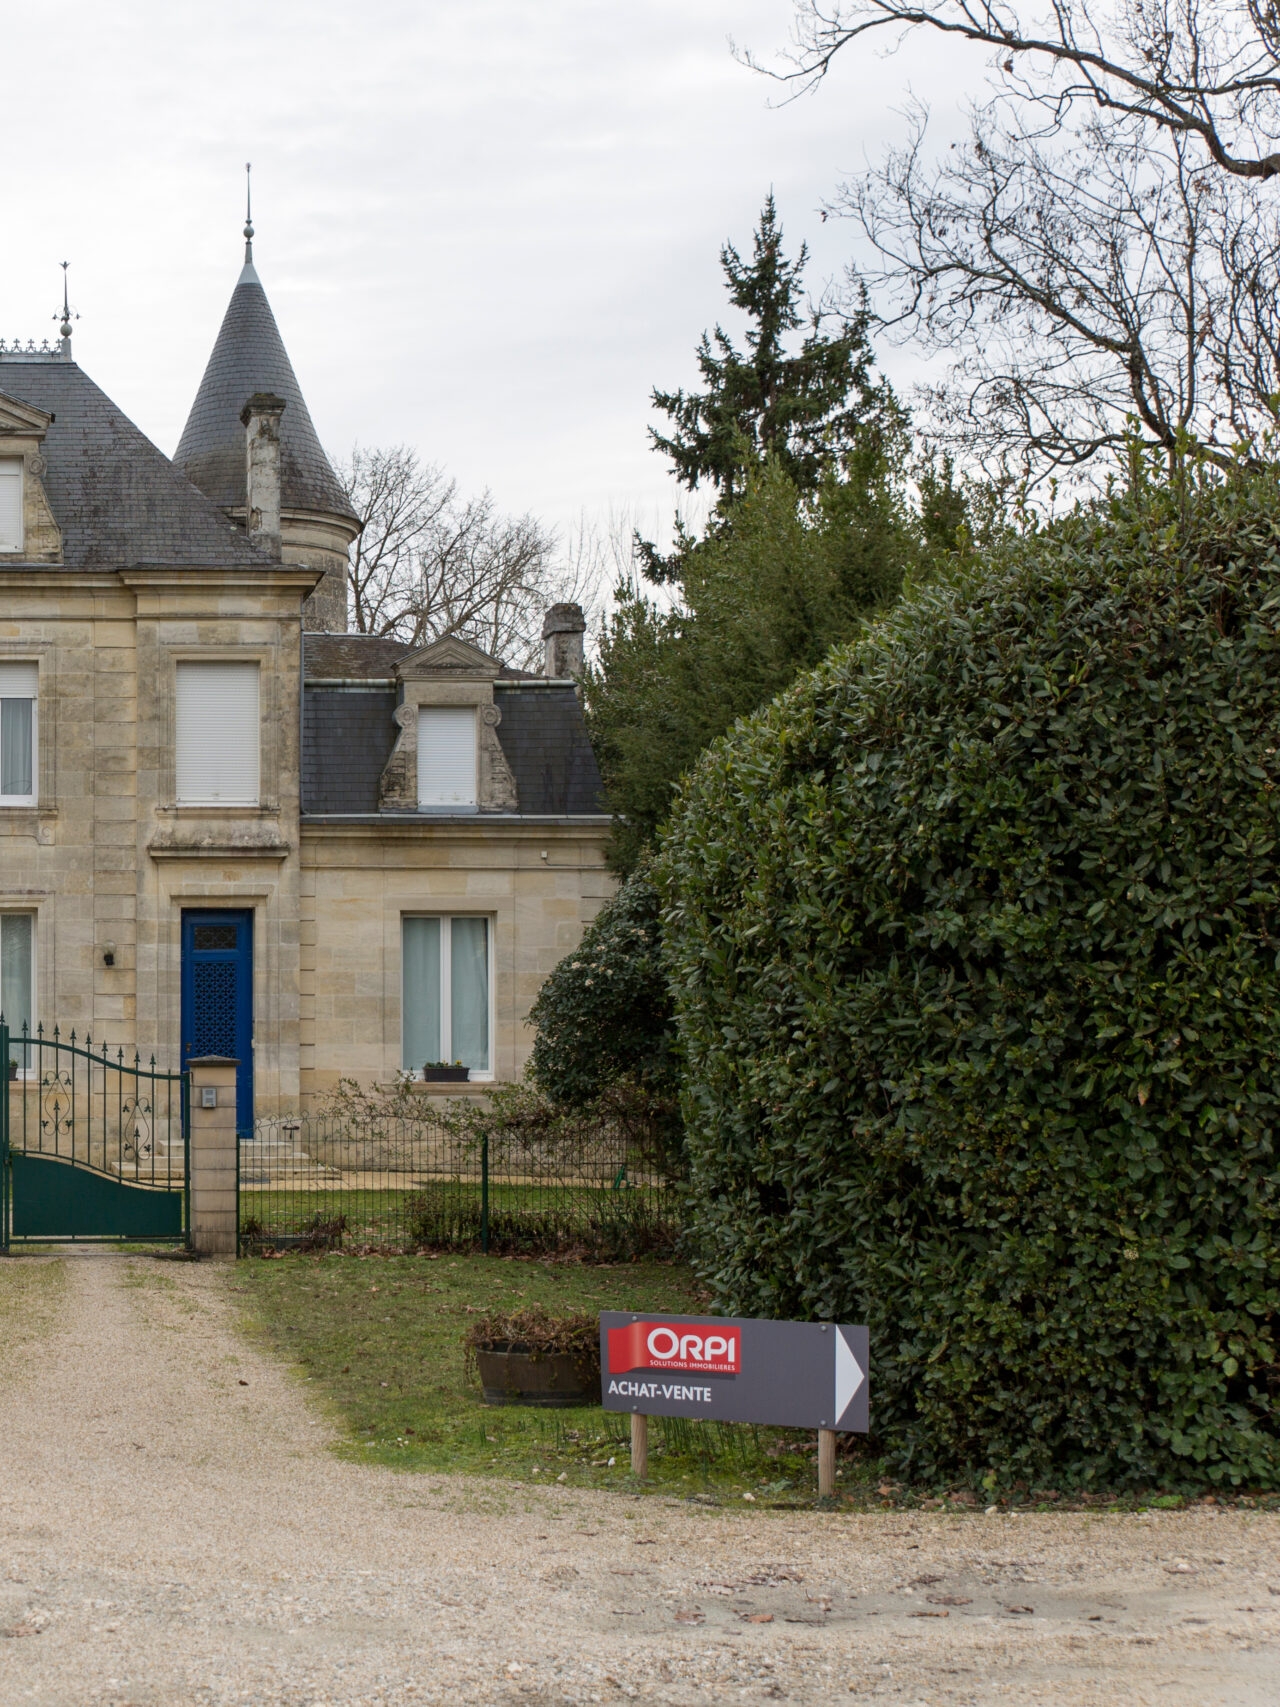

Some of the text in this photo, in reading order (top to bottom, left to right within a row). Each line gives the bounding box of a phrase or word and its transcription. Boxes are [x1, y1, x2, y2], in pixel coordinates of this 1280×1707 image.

[647, 1327, 735, 1362] ORPI
[649, 1360, 735, 1371] SOLUTIONS IMMOBILIERES
[608, 1380, 712, 1402] ACHAT-VENTE
